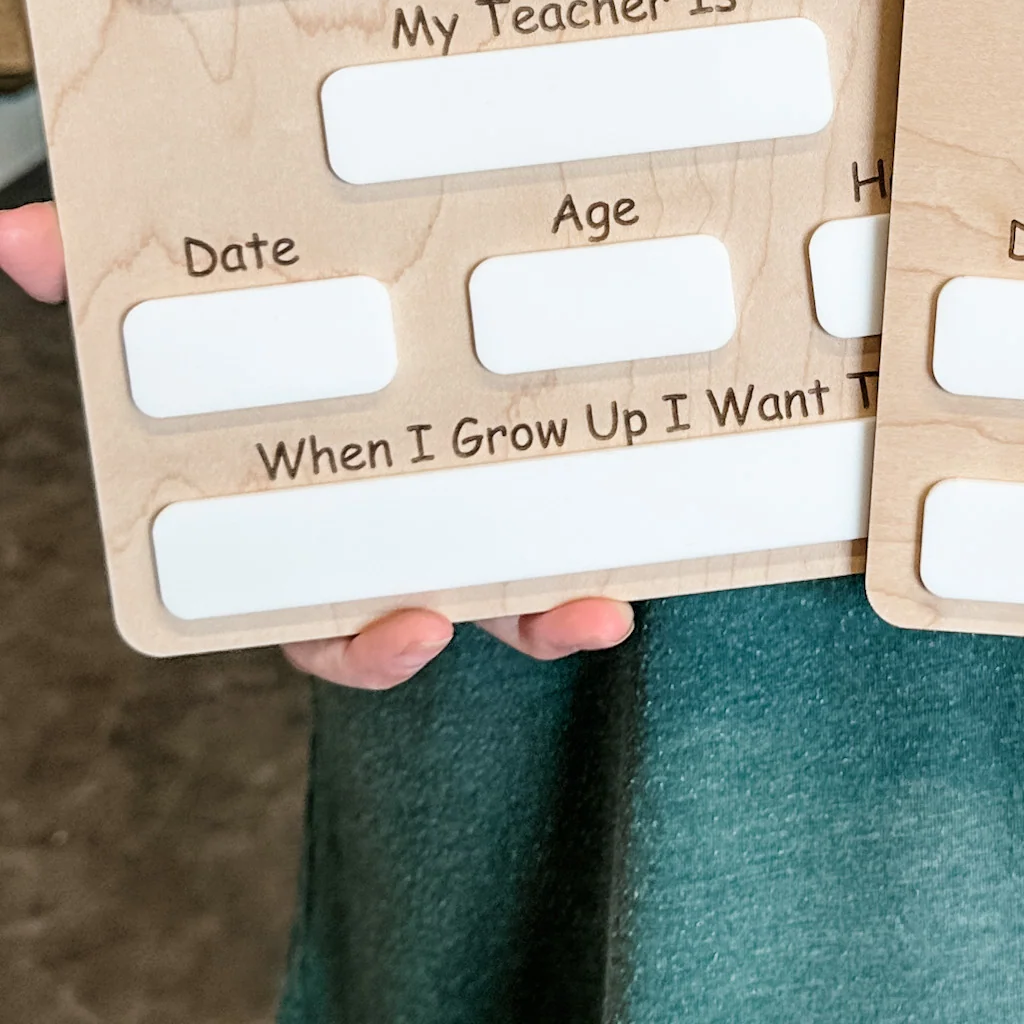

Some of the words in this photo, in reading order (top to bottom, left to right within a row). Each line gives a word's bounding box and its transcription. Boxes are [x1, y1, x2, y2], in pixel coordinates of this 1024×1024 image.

[391, 5, 459, 55] My
[550, 193, 640, 243] Age
[184, 232, 300, 278] Date
[255, 435, 394, 481] When
[406, 423, 434, 464] I
[452, 411, 568, 460] Grow
[586, 400, 649, 447] Up
[662, 393, 692, 433] I
[706, 378, 830, 428] Want
[846, 371, 879, 409] T
